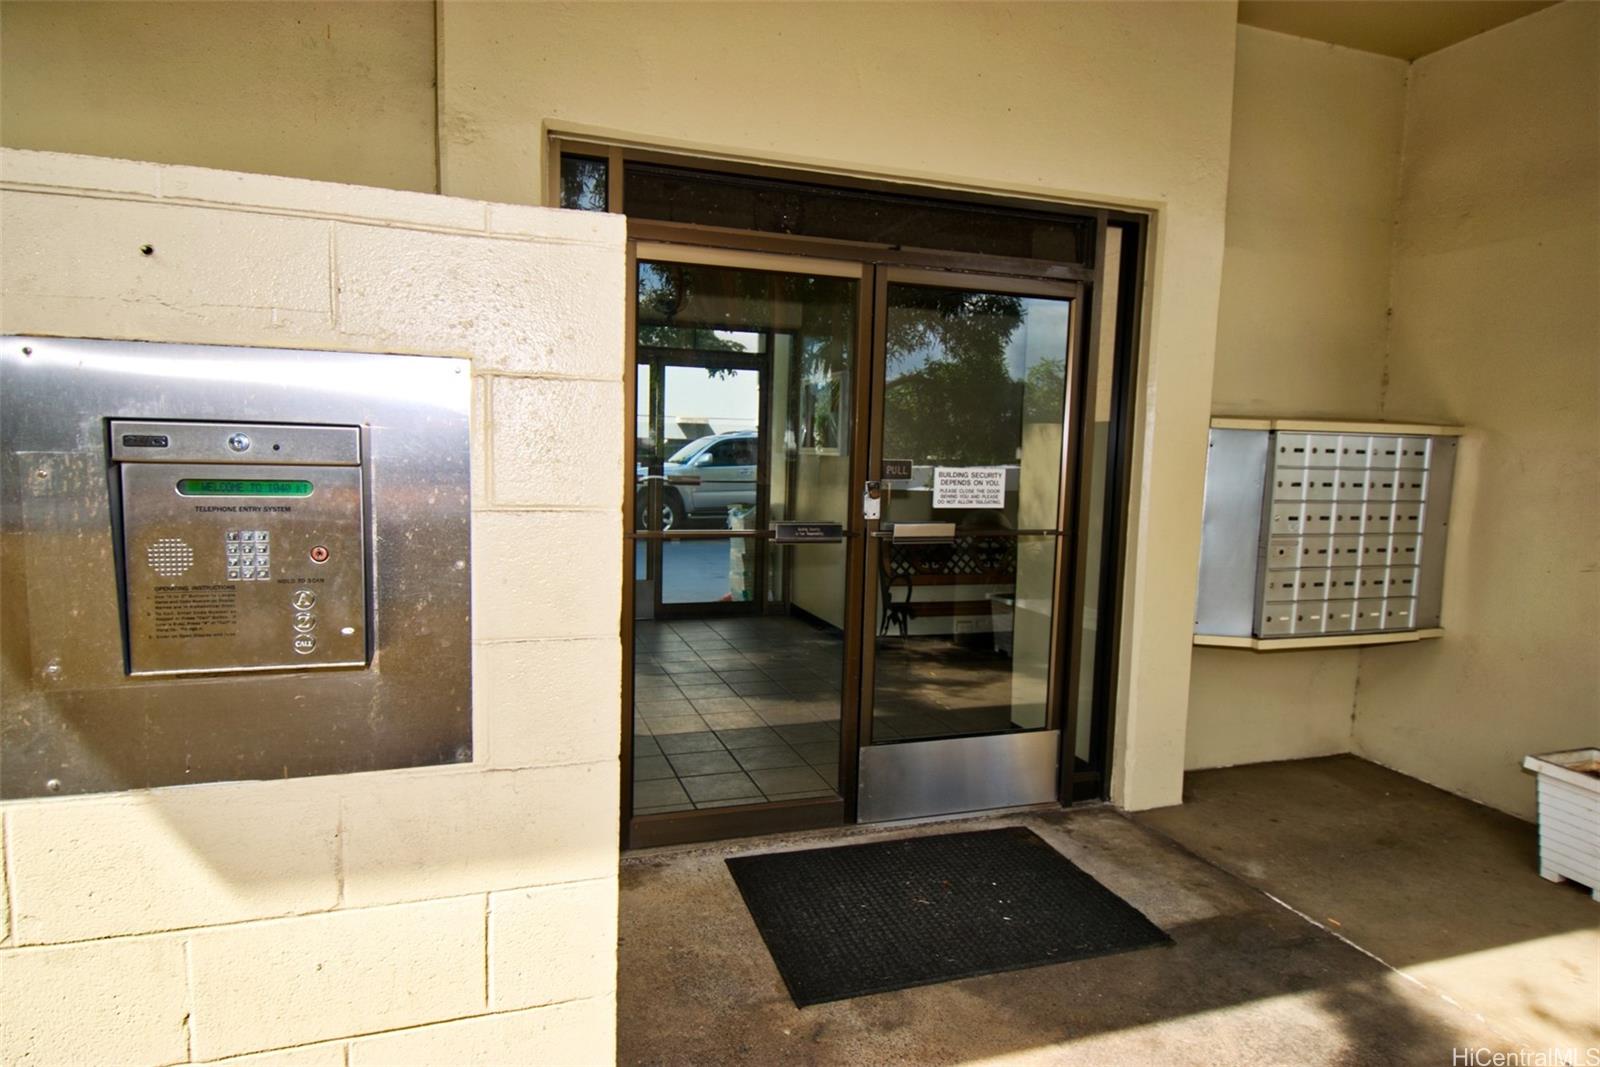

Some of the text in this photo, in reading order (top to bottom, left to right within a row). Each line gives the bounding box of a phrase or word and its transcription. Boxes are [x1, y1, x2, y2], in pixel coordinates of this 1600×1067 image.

[886, 465, 908, 475] PULL
[938, 471, 1002, 479] BUILDING SECURITY
[201, 482, 244, 493] WELCOME
[250, 482, 262, 493] TO
[195, 505, 237, 513] TELEPHONE
[239, 505, 261, 513] ENTRY
[297, 592, 310, 606] A
[297, 615, 310, 629] Z
[295, 640, 313, 648] CALL
